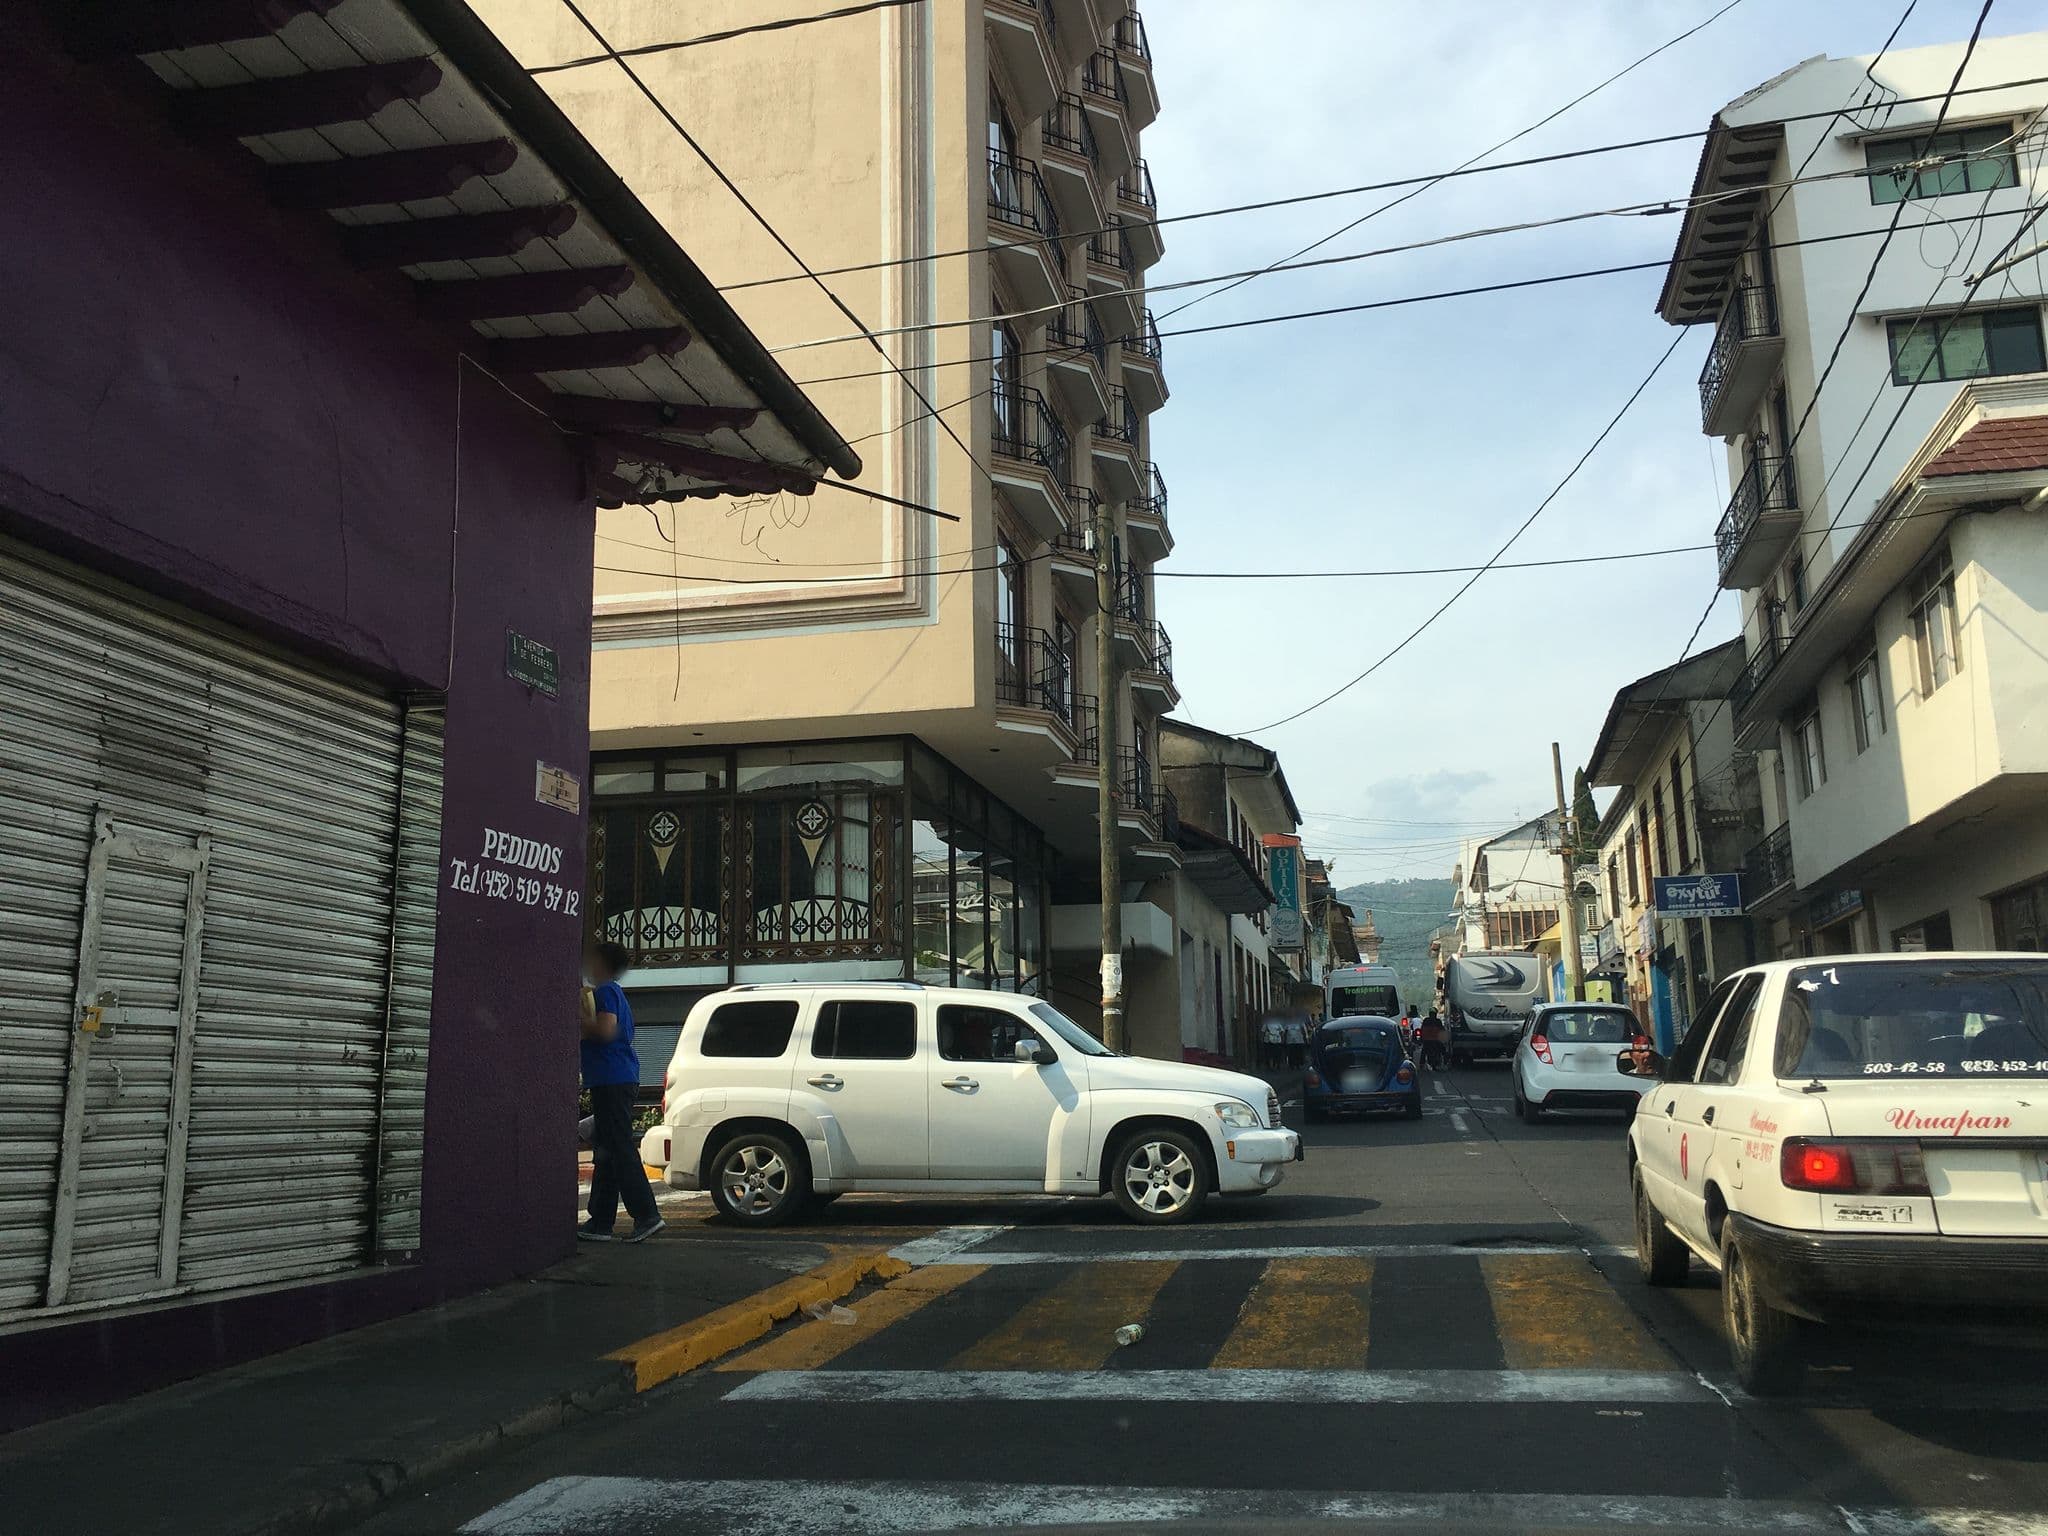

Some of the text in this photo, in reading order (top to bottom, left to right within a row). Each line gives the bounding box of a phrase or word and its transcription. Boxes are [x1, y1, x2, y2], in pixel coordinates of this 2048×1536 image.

[531, 653, 553, 672] FEBRERO
[481, 828, 563, 874] PEDIDOS
[1276, 848, 1292, 908] OPTICA
[480, 869, 514, 900] (452)
[516, 876, 541, 906] 519
[544, 881, 563, 911] 37
[563, 889, 580, 917] 12
[1666, 885, 1721, 903] exytur
[1822, 967, 1840, 985] 7
[1863, 1062, 1946, 1074] 503-12-58
[1884, 1107, 2012, 1137] Uruapan
